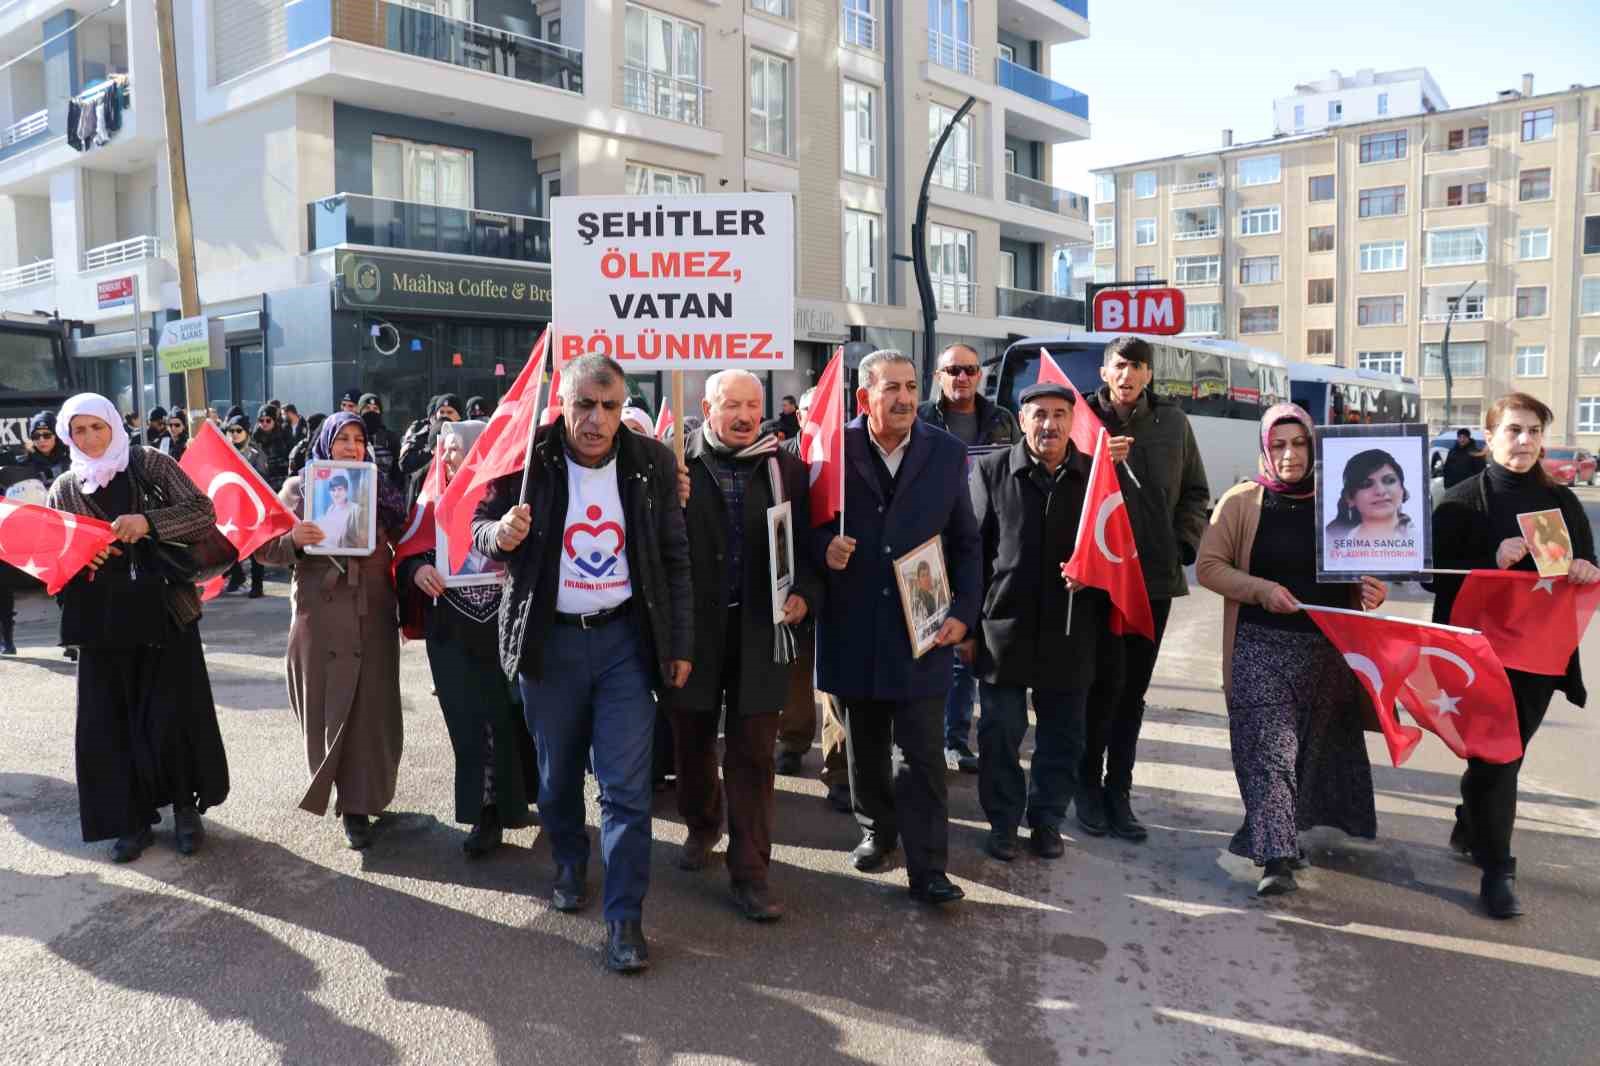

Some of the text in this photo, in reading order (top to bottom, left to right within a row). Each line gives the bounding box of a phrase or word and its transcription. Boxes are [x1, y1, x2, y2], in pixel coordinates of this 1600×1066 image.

[577, 204, 766, 245] ŞEHİTLER
[600, 247, 742, 283] ÖLMEZ,
[392, 272, 454, 296] Maâhsa
[459, 278, 508, 299] Coffee
[511, 283, 526, 300] &
[608, 292, 733, 319] VATAN
[1101, 289, 1175, 329] BİM
[561, 328, 784, 361] BÖLÜNMEZ.
[1374, 538, 1415, 548] SANCAR
